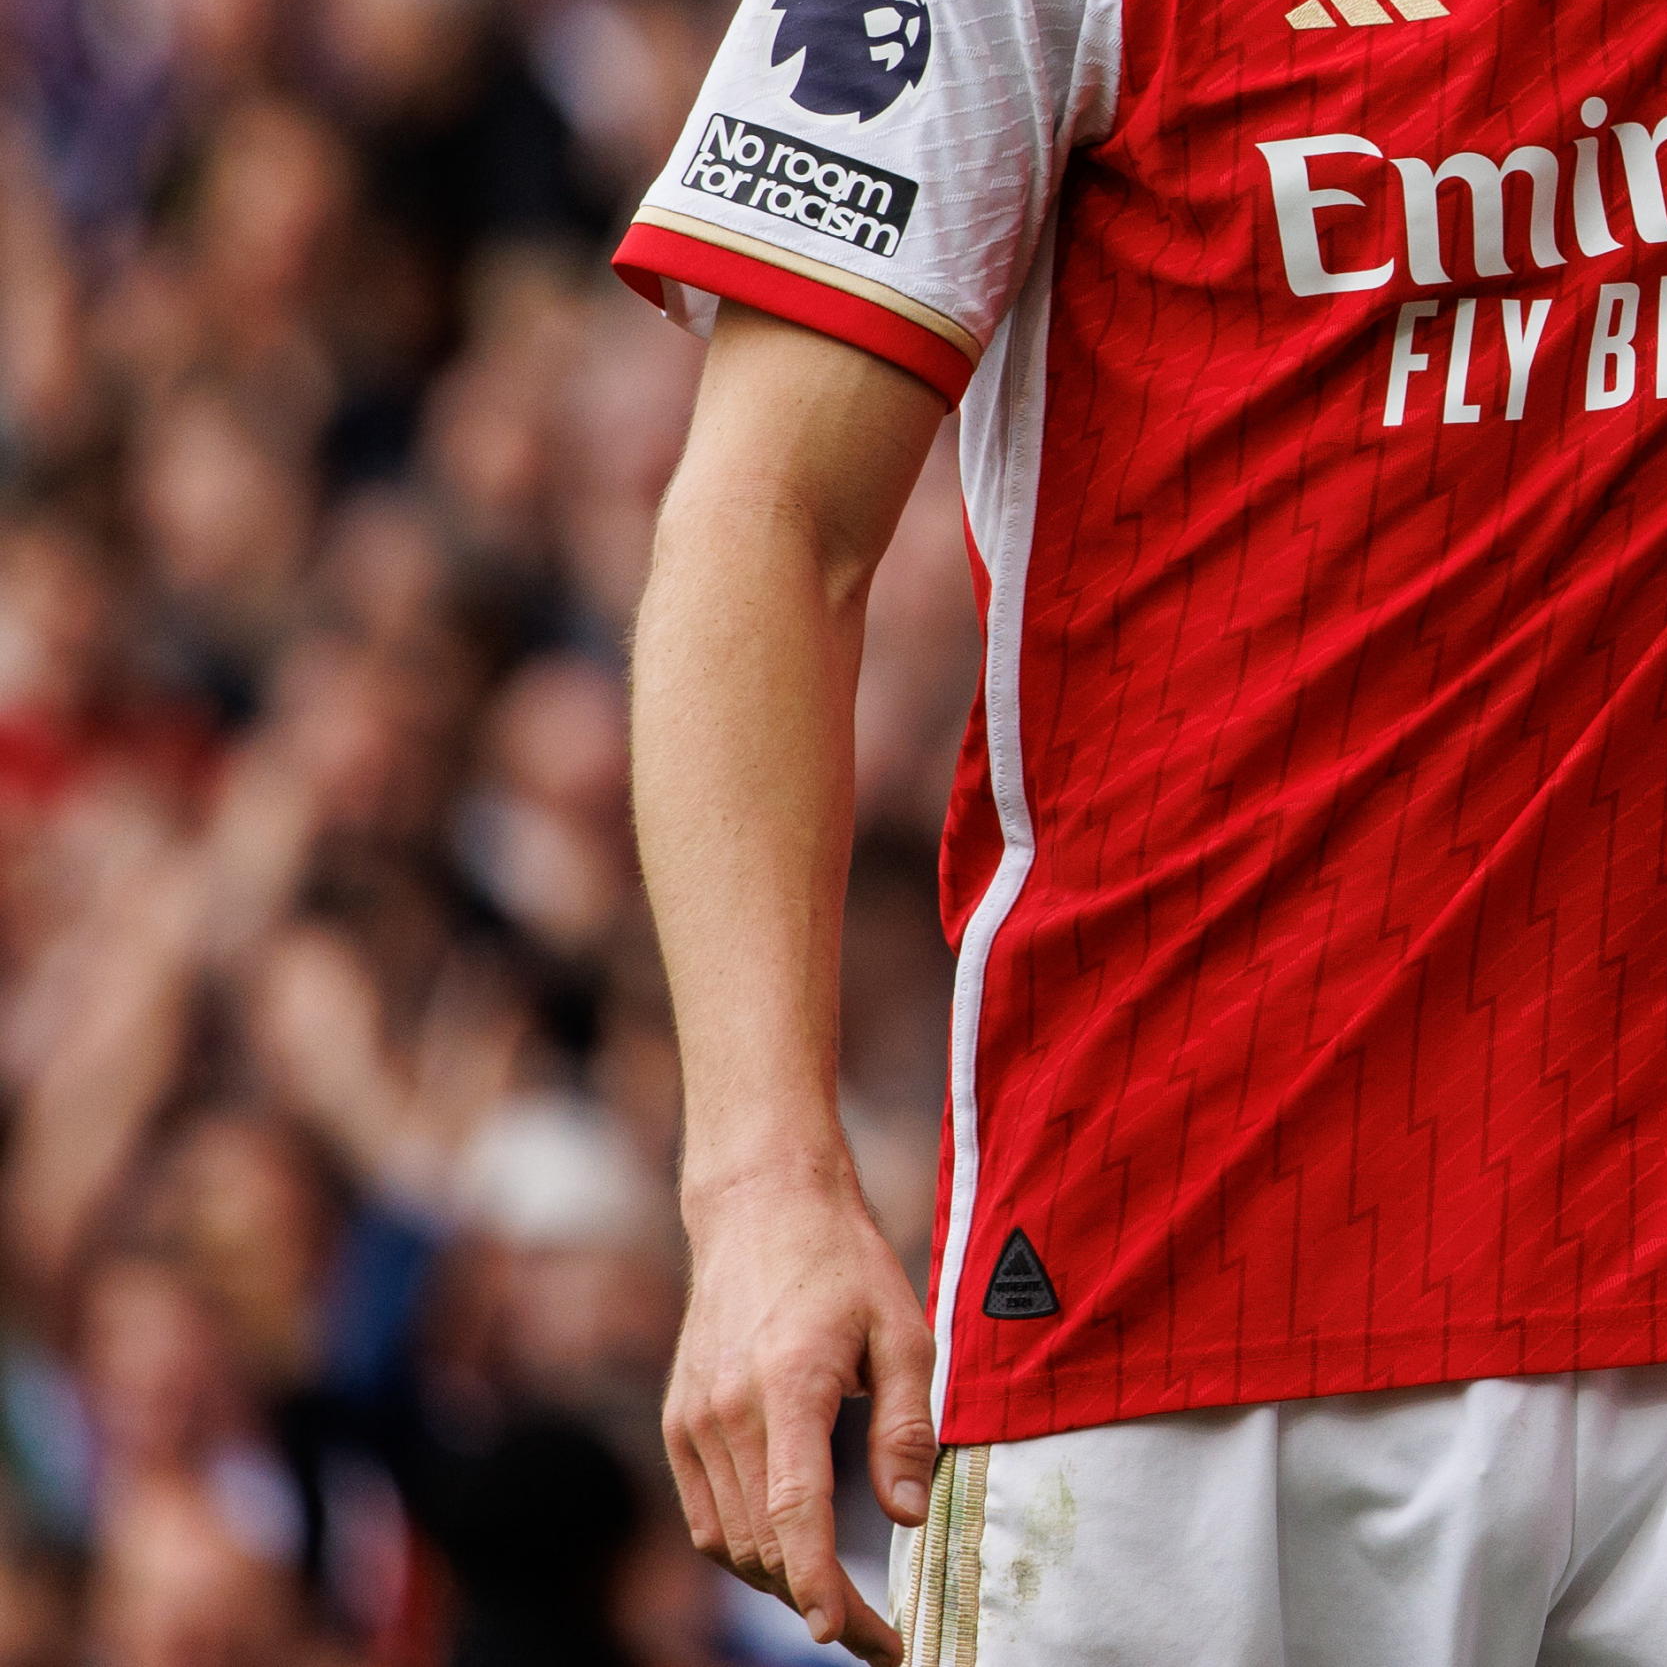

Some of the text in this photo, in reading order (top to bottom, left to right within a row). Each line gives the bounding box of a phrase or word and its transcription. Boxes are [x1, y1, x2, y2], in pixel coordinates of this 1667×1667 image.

[682, 151, 900, 256] for racism
[699, 114, 893, 216] No room
[1381, 298, 1552, 428] FLY
